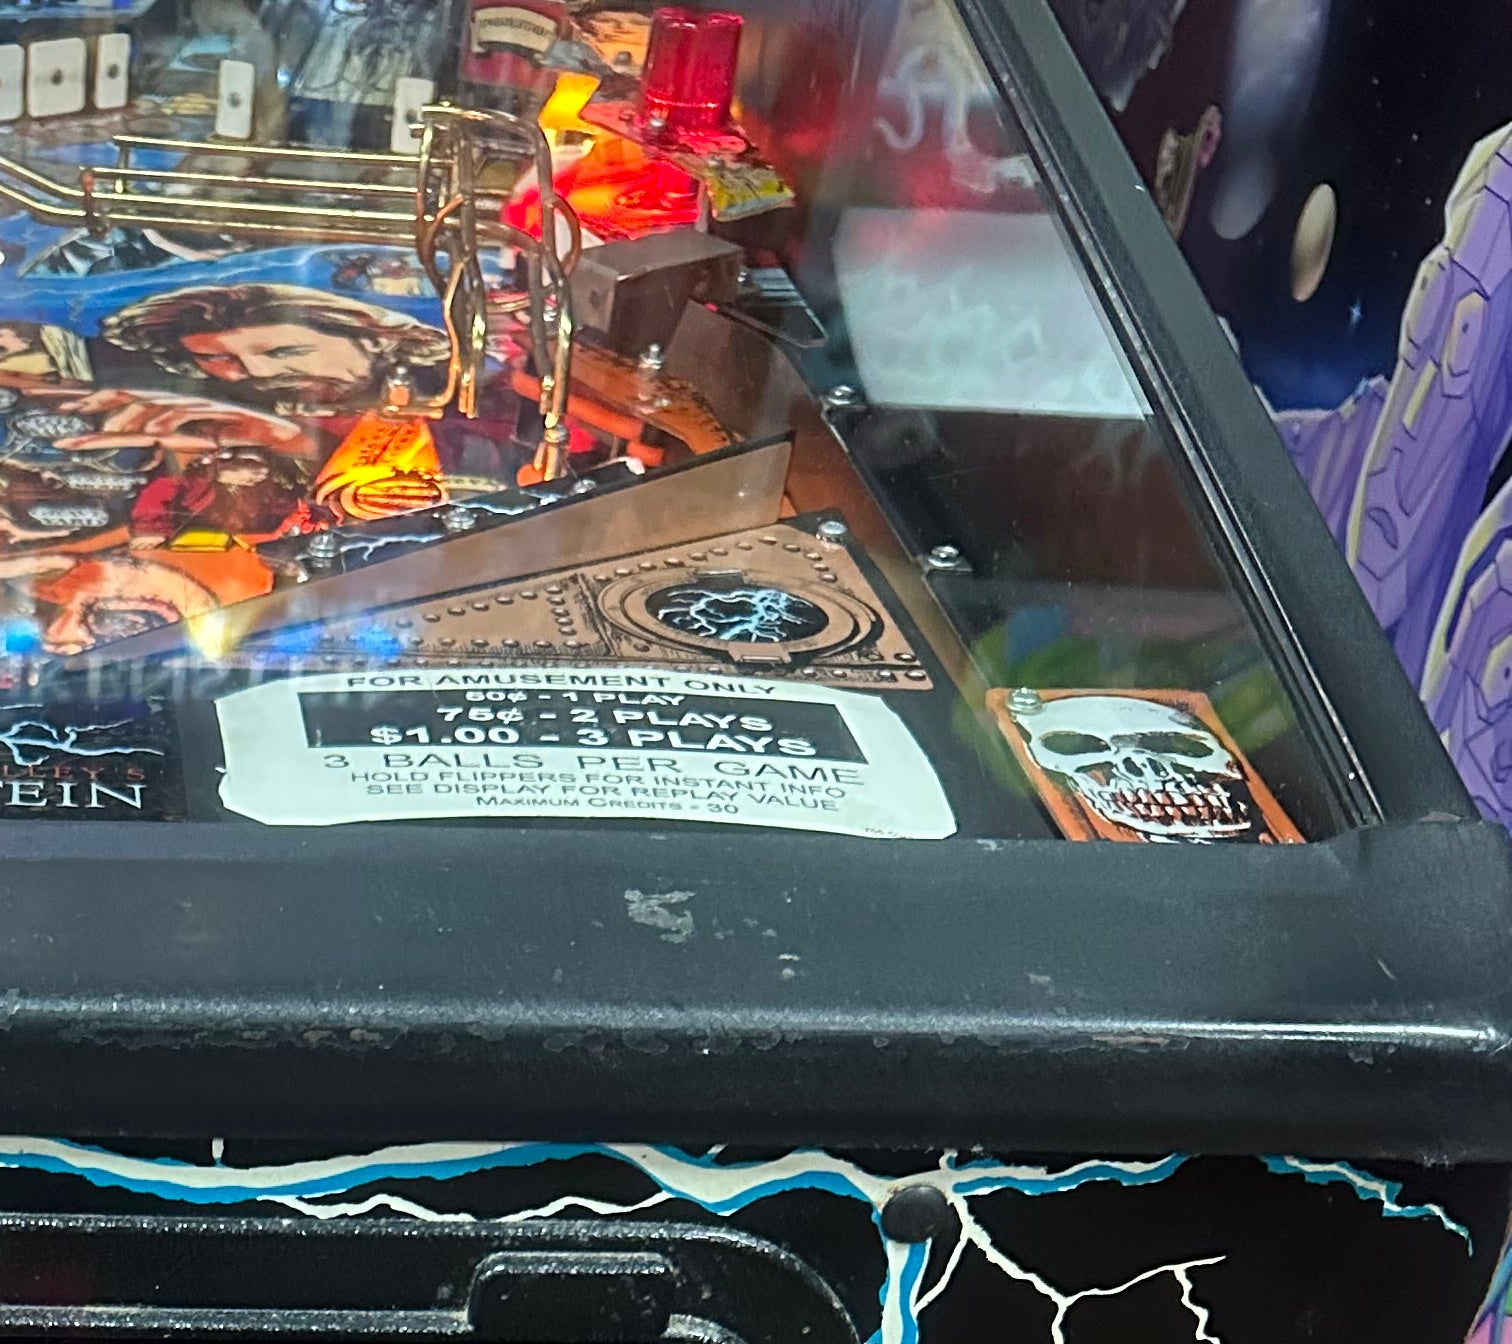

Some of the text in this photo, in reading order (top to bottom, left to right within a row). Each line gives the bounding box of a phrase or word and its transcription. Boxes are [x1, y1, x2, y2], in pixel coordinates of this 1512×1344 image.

[347, 674, 777, 695] FOR AMUSEMENT ONLY
[561, 692, 579, 702] 1
[592, 692, 686, 706] PLAY
[436, 706, 524, 725] 75¢
[570, 708, 599, 723] 2
[612, 708, 774, 732] PLAYS
[369, 725, 520, 746] $1.00
[575, 728, 610, 746] 3
[627, 729, 818, 757] PLAYS
[323, 753, 865, 786] 3 BALLS PER GAME
[351, 771, 846, 799] HOLD FLIPPERS FOR INSTANT INFO
[366, 784, 841, 812] SEE DISPLAY FOR REPLAY VALUE
[707, 803, 739, 815] 30
